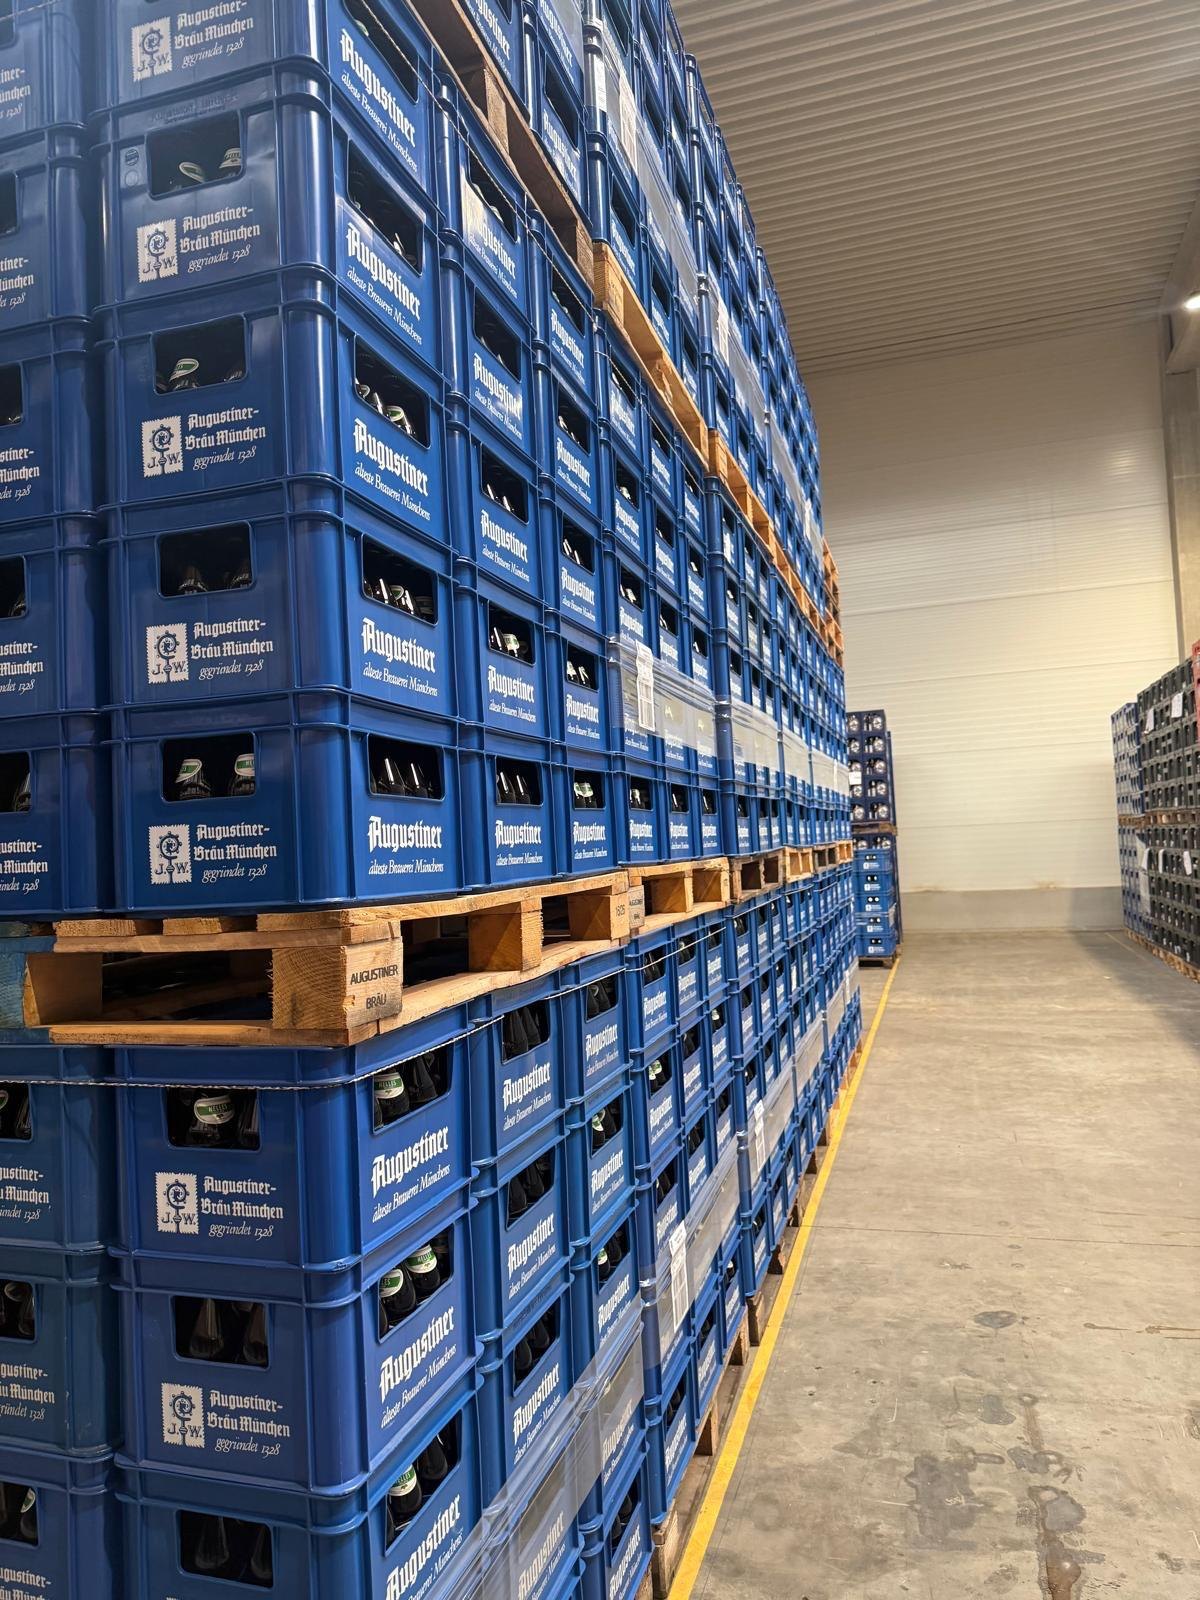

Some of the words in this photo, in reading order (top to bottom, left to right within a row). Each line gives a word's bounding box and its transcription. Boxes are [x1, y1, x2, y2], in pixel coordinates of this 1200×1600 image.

[177, 0, 247, 31] Augustiner-
[174, 31, 204, 50] Bräu
[204, 18, 254, 41] München
[225, 37, 245, 57] 1328
[340, 27, 415, 148] Augustiner
[182, 206, 253, 234] Augustiner-
[179, 234, 209, 253] Bräu
[210, 225, 260, 246] München
[187, 247, 229, 274] gegründet
[231, 244, 251, 264] 1328
[346, 221, 420, 320] Augustiner
[187, 407, 259, 431] Augustiner-
[185, 433, 215, 450] Bräu
[216, 427, 266, 445] München
[192, 447, 235, 471] gegründet
[237, 445, 257, 464] 1328
[353, 417, 428, 497] Augustiner
[480, 509, 528, 563] Augustiner
[193, 618, 266, 640] Augustiner-
[190, 643, 221, 659] Bräu
[222, 639, 273, 657] München
[361, 617, 435, 673] Augustiner
[198, 659, 241, 681] gegründet
[244, 659, 264, 677] 1328
[18, 679, 35, 696] 1328
[488, 665, 535, 704] Augustiner
[196, 822, 270, 841] Augustiner-
[367, 815, 442, 853] Augustiner
[495, 819, 542, 849] Augustiner
[193, 845, 225, 861] Bräu
[225, 844, 277, 860] München
[3, 859, 48, 875] München
[201, 862, 245, 883] gegründet
[248, 863, 268, 881] 1328
[22, 878, 40, 895] 1328
[350, 965, 398, 985] AUGUSTINER
[366, 992, 387, 1009] BRÄU
[502, 1062, 551, 1113] Augustiner
[371, 1126, 448, 1199] Augustiner
[5, 1185, 49, 1205] München
[203, 1176, 276, 1195] Augustiner-
[24, 1209, 40, 1224] 1328
[200, 1198, 231, 1215] Bräu
[232, 1201, 283, 1220] München
[208, 1220, 251, 1238] gegründet
[254, 1225, 274, 1241] 1328
[507, 1213, 554, 1281] Augustiner
[379, 1305, 455, 1405] Augustiner
[10, 1383, 55, 1404] München
[210, 1389, 283, 1413] Augustiner-
[513, 1362, 560, 1446] Augustiner
[207, 1411, 238, 1430] Bräu
[239, 1416, 290, 1437] München
[215, 1436, 258, 1453] gegründet
[261, 1442, 281, 1458] 1328
[386, 1493, 461, 1600] Augustiner
